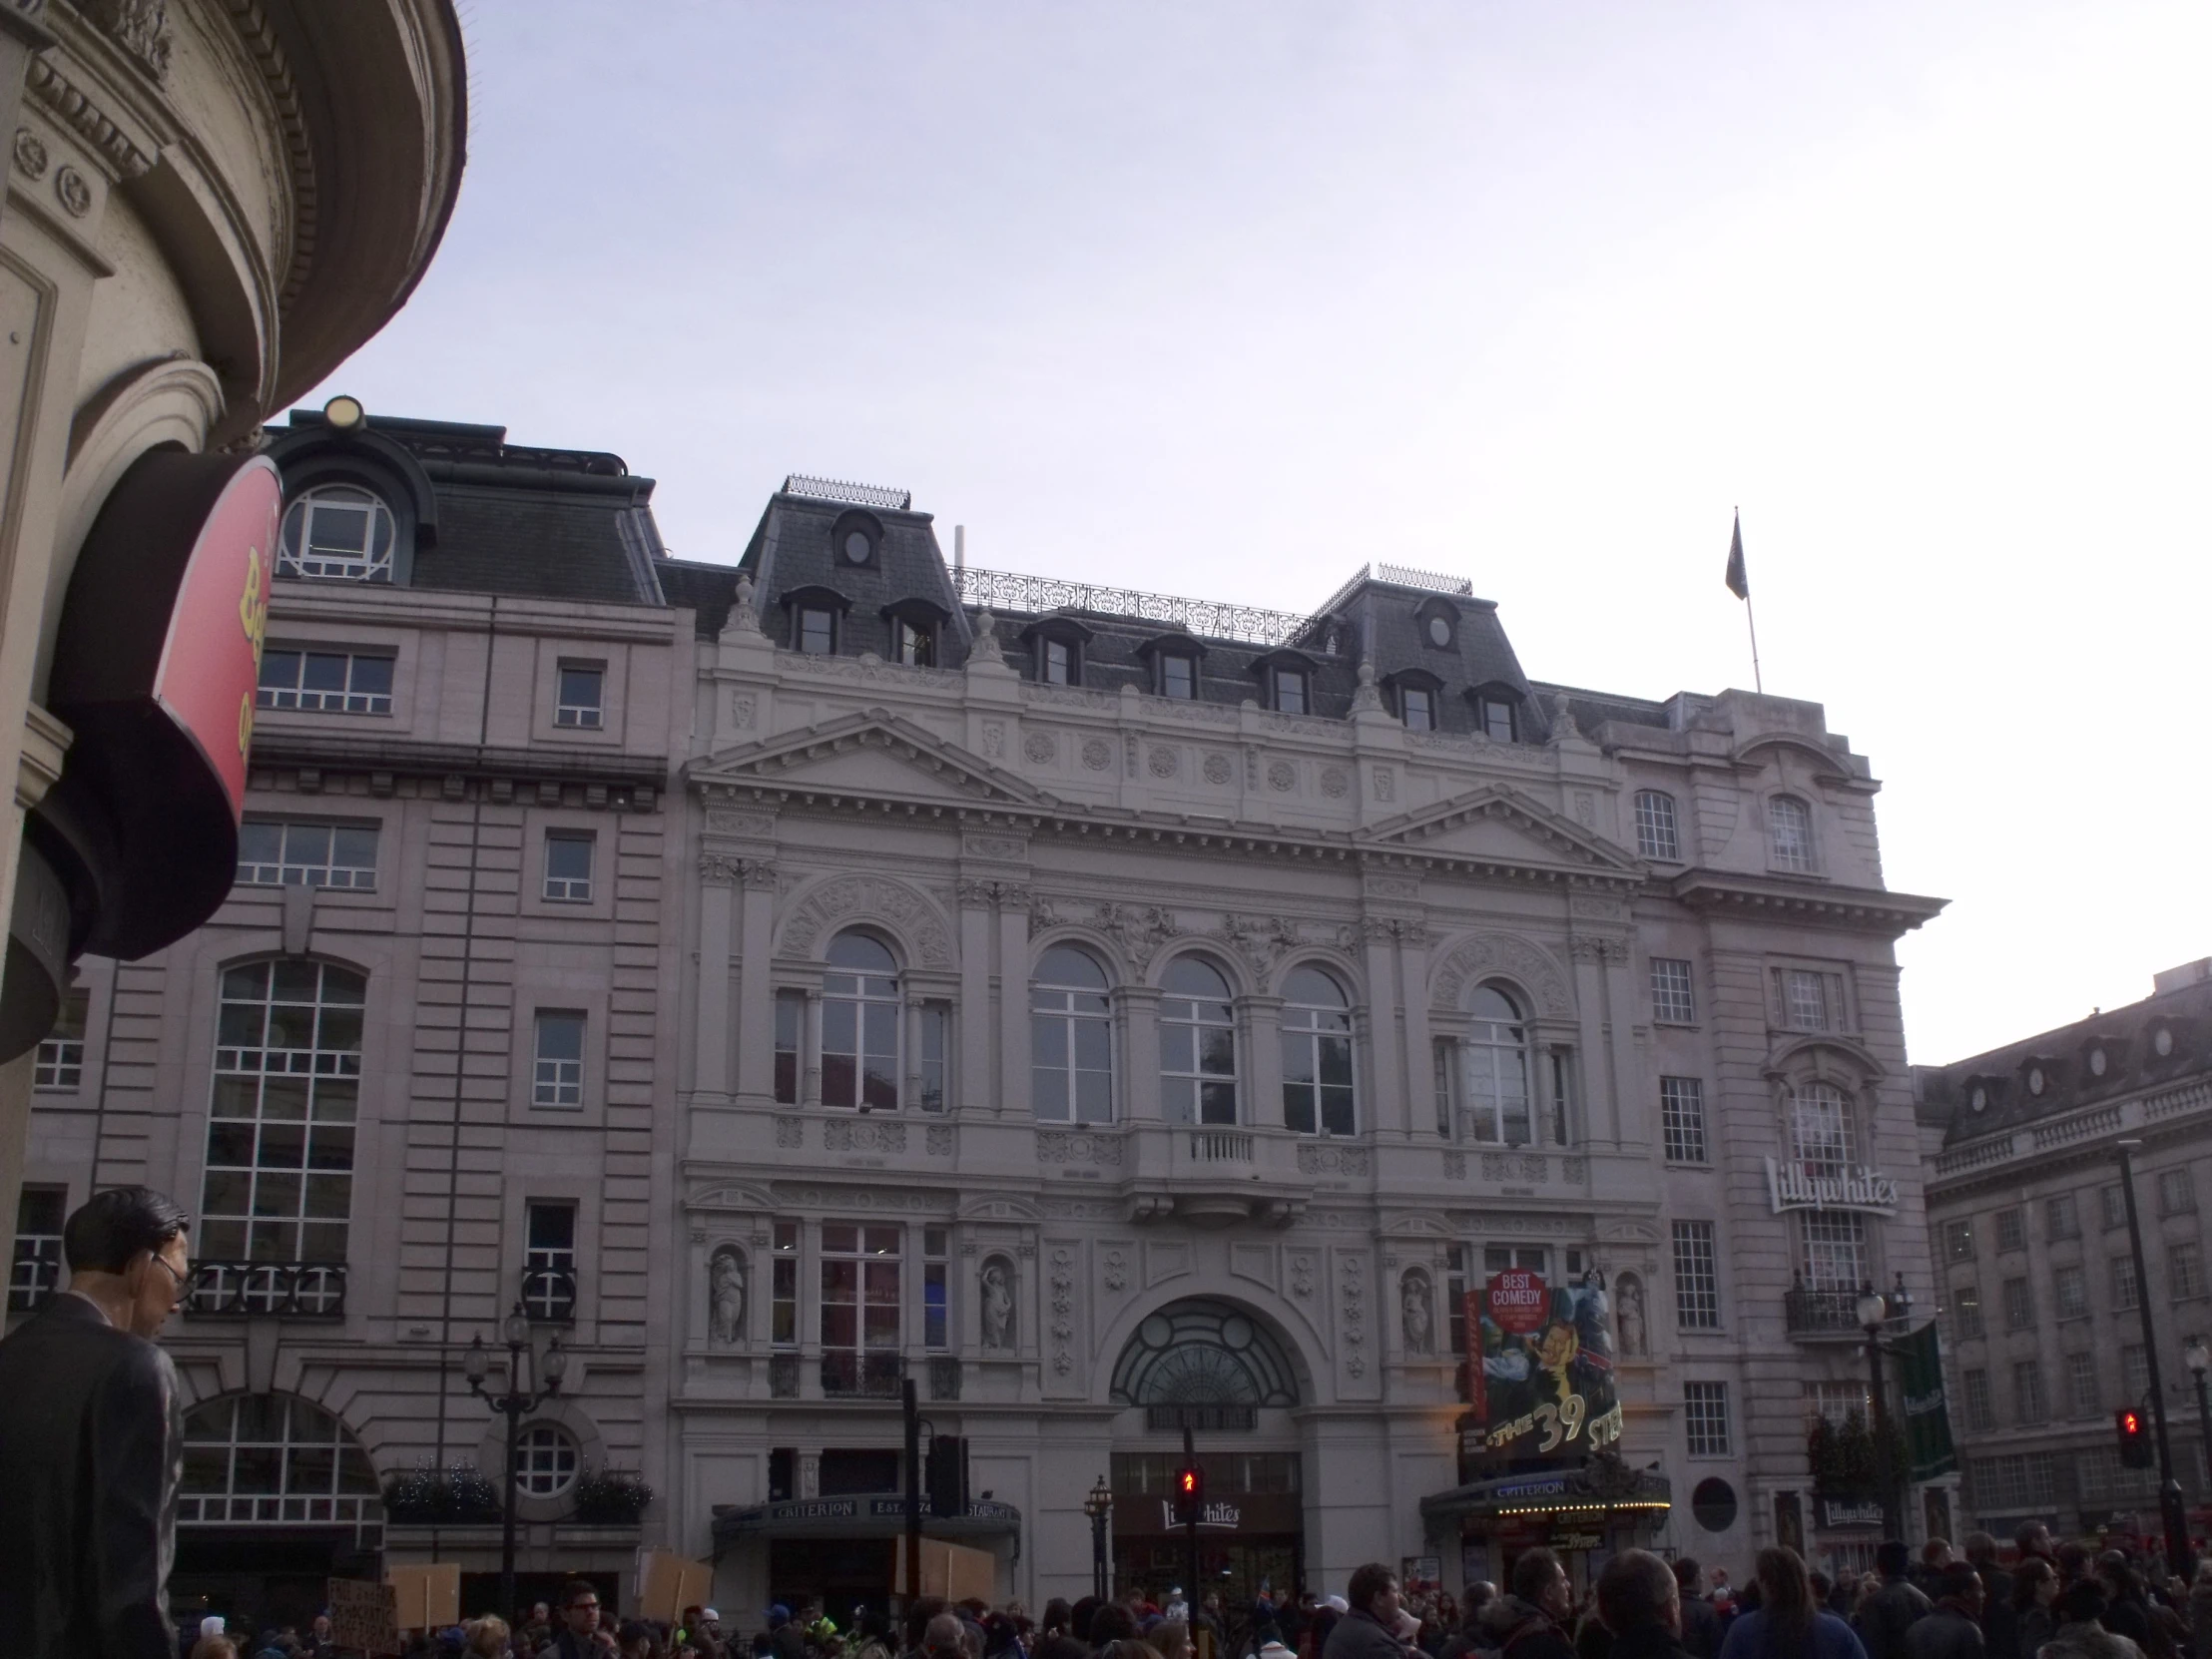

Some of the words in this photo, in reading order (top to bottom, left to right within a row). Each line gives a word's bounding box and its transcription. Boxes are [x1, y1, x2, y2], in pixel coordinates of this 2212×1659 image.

[1765, 1154, 1899, 1216] Lillywhites
[1502, 1274, 1530, 1290] BEST
[1492, 1290, 1541, 1306] COMEDY
[1533, 1393, 1585, 1453] 39
[1497, 1481, 1565, 1497] CRITERION
[778, 1501, 852, 1518] CRITERION
[876, 1502, 903, 1513] EST.
[968, 1503, 1006, 1518] STAURANT
[1824, 1499, 1884, 1527] Lillywhites
